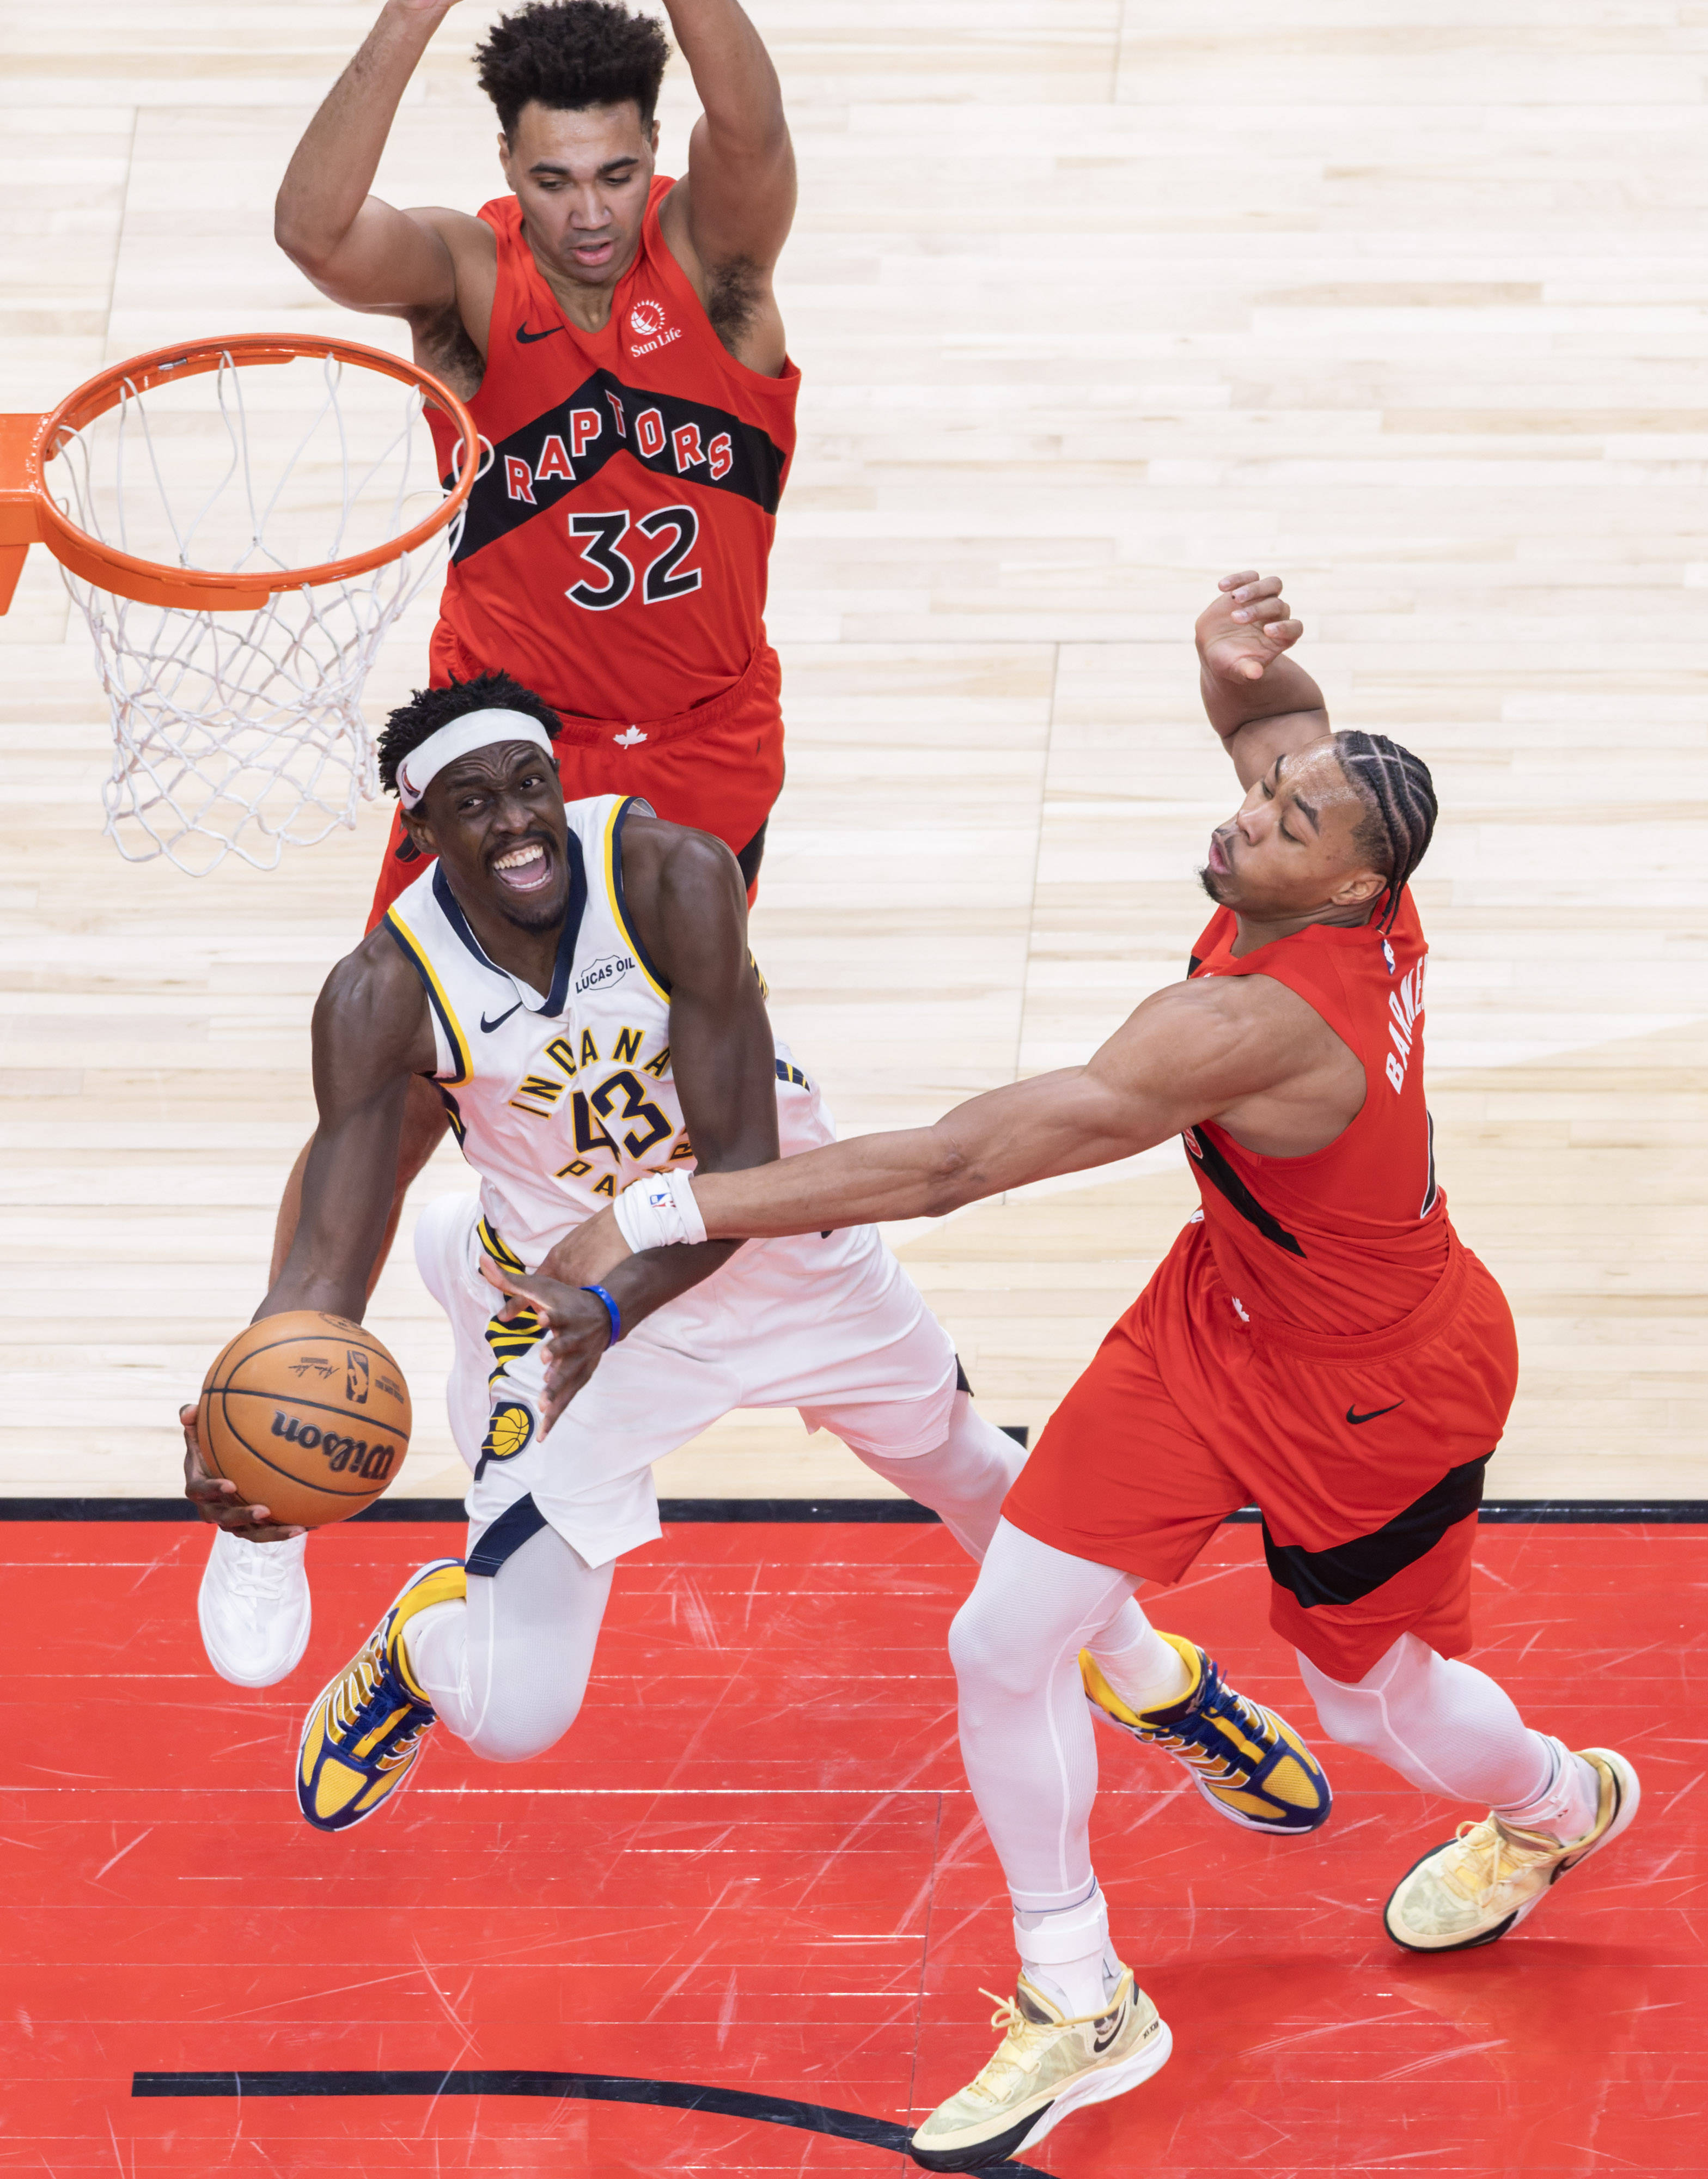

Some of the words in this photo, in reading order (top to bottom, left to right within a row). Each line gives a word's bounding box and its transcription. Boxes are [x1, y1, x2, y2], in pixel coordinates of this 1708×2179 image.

[631, 340, 658, 357] Sun
[657, 327, 682, 346] Life
[504, 389, 733, 504] RAPTORS
[565, 505, 701, 611] 32
[576, 964, 613, 994] LUCAS
[616, 957, 636, 972] OIL
[1386, 953, 1428, 1094] BARNE
[509, 1026, 670, 1120] INDANA
[569, 1069, 673, 1164] 43
[271, 1410, 395, 1481] Wilson
